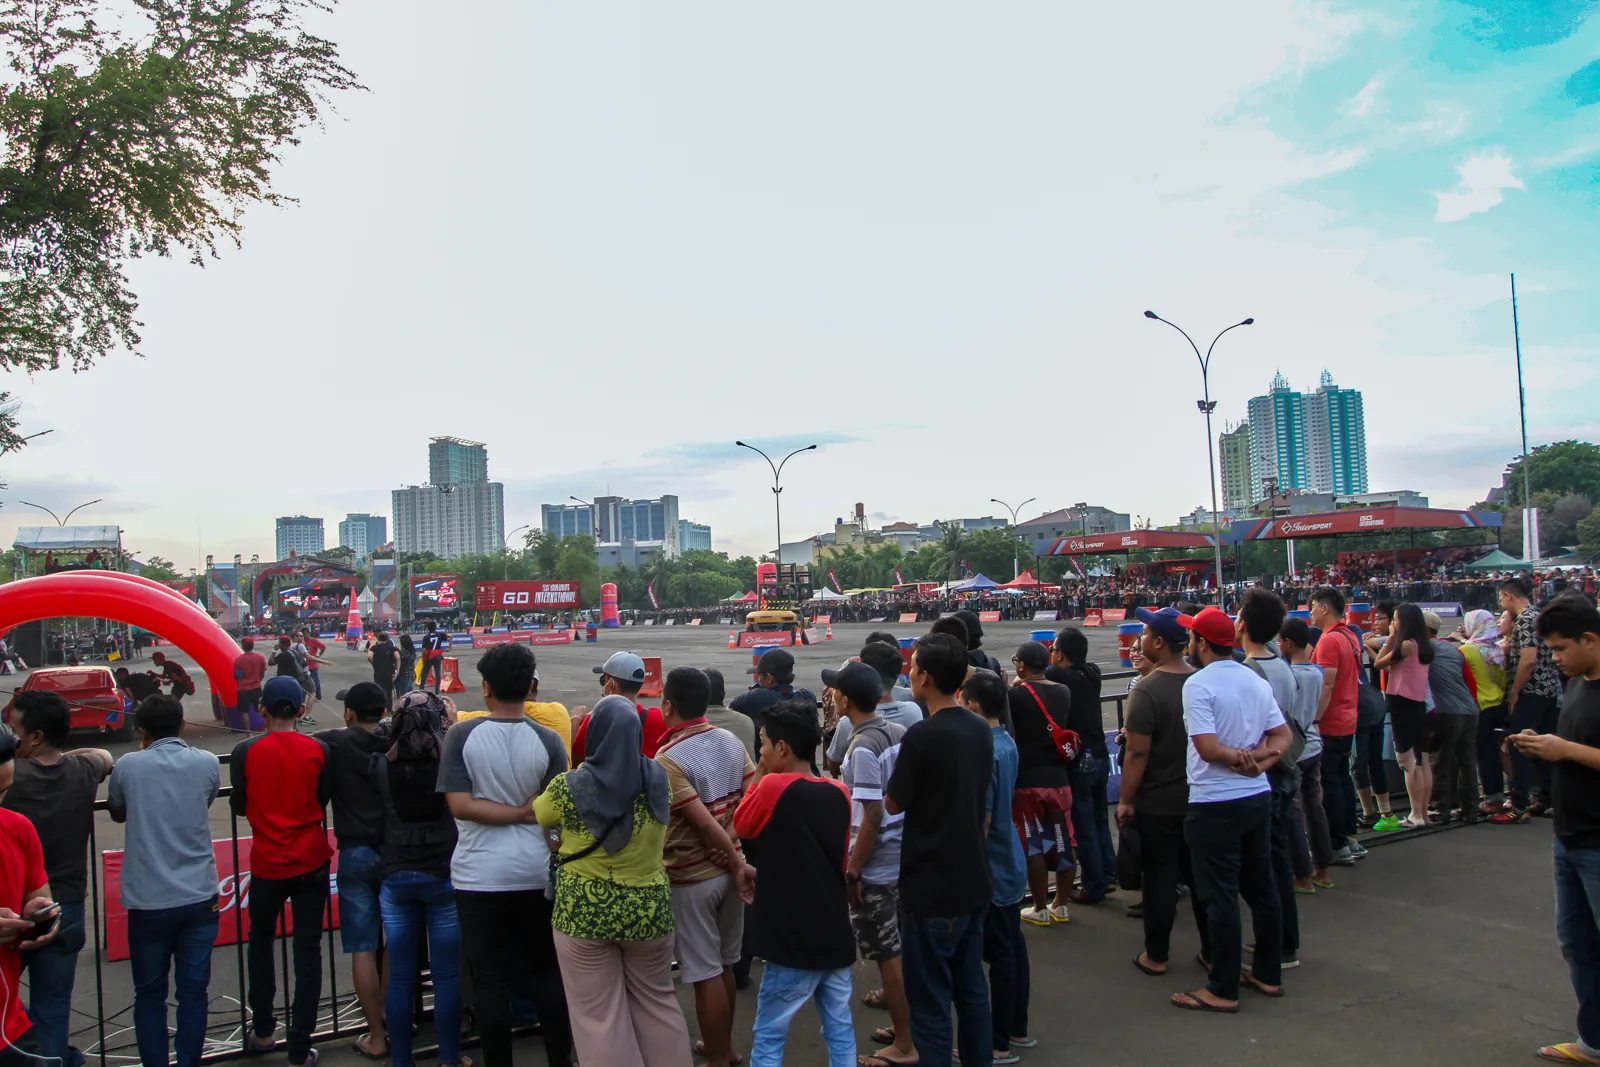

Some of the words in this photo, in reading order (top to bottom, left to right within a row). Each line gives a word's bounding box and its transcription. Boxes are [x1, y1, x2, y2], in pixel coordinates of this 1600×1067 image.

[1292, 521, 1333, 532] InterSPORT
[503, 592, 529, 604] GO
[430, 636, 439, 650] 7
